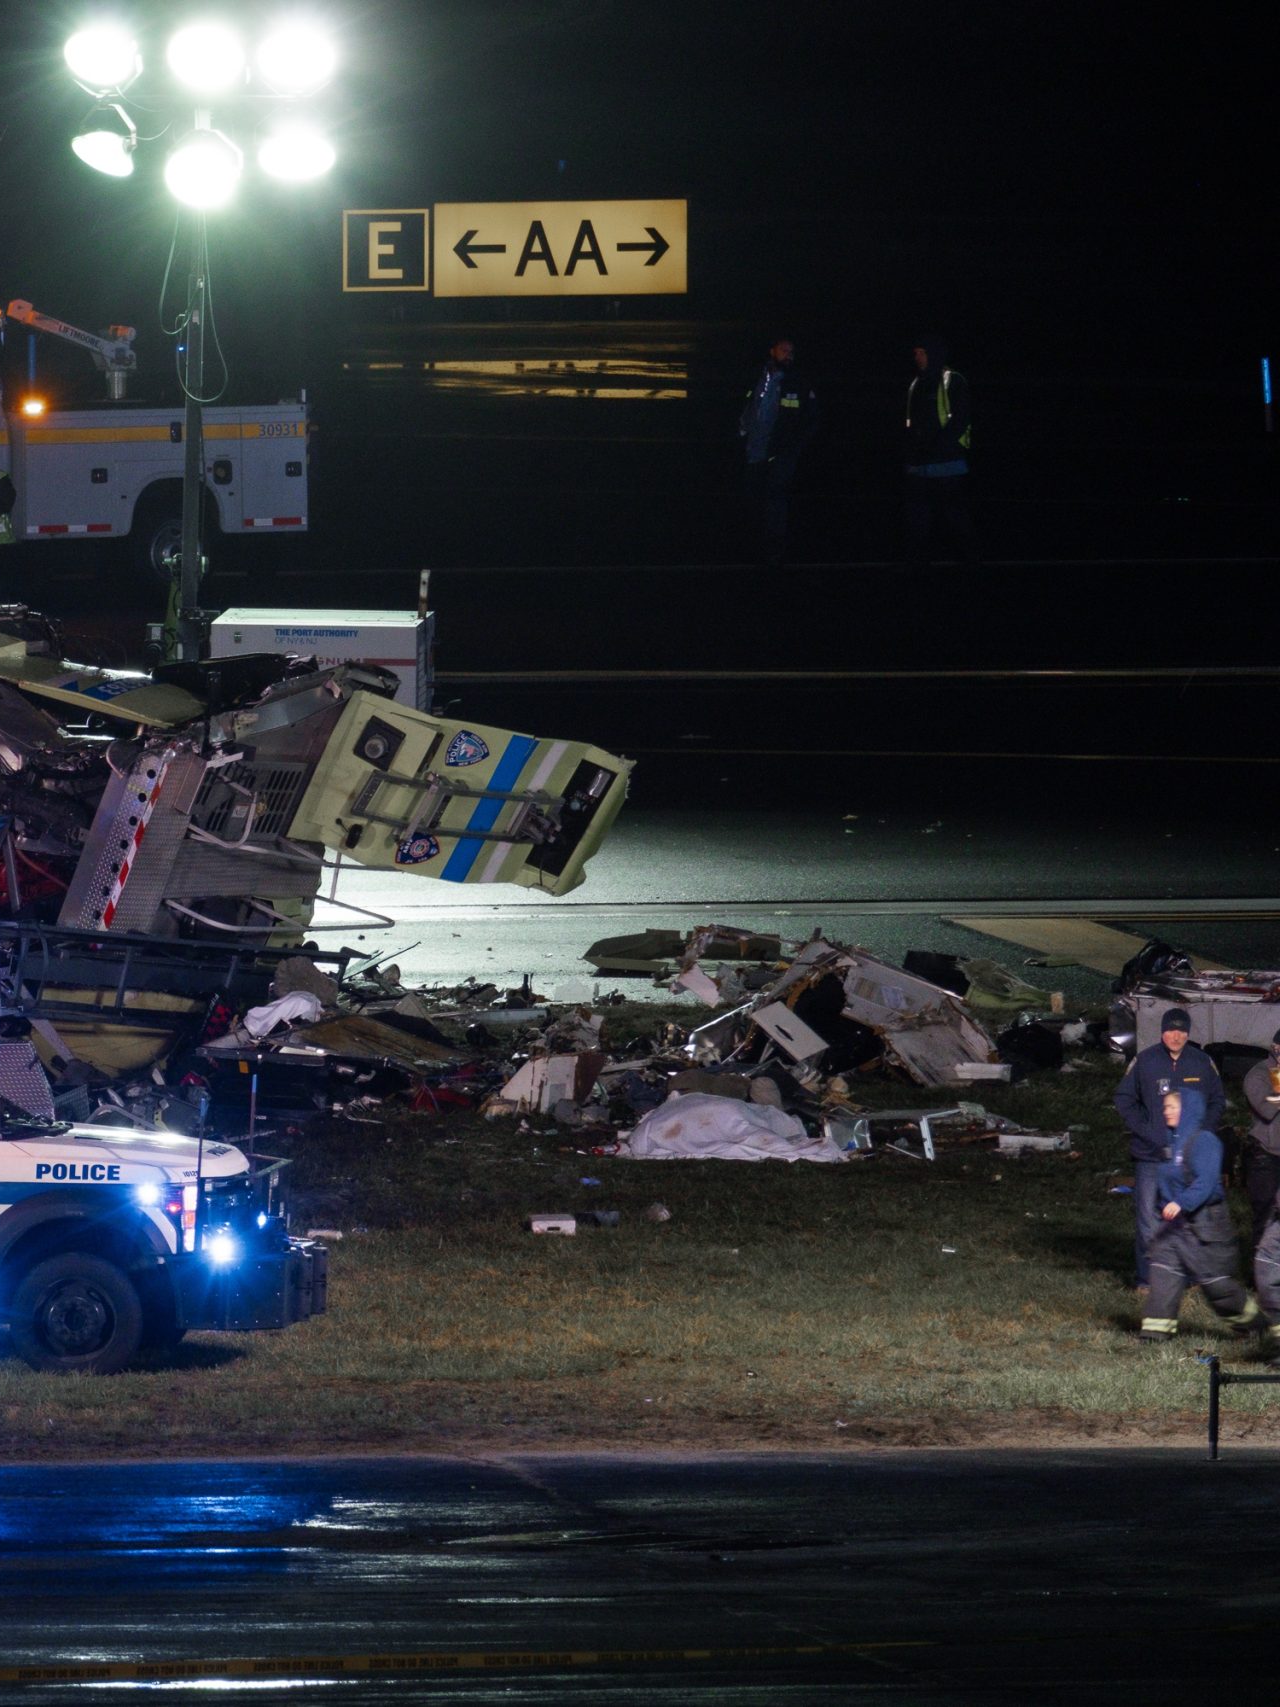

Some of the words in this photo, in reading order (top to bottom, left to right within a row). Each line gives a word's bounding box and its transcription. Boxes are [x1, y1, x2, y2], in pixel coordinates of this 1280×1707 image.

[369, 222, 403, 279] E
[514, 220, 608, 277] AA
[259, 423, 297, 436] 30931
[313, 629, 359, 637] AUTHORITY
[35, 1163, 120, 1181] POLICE
